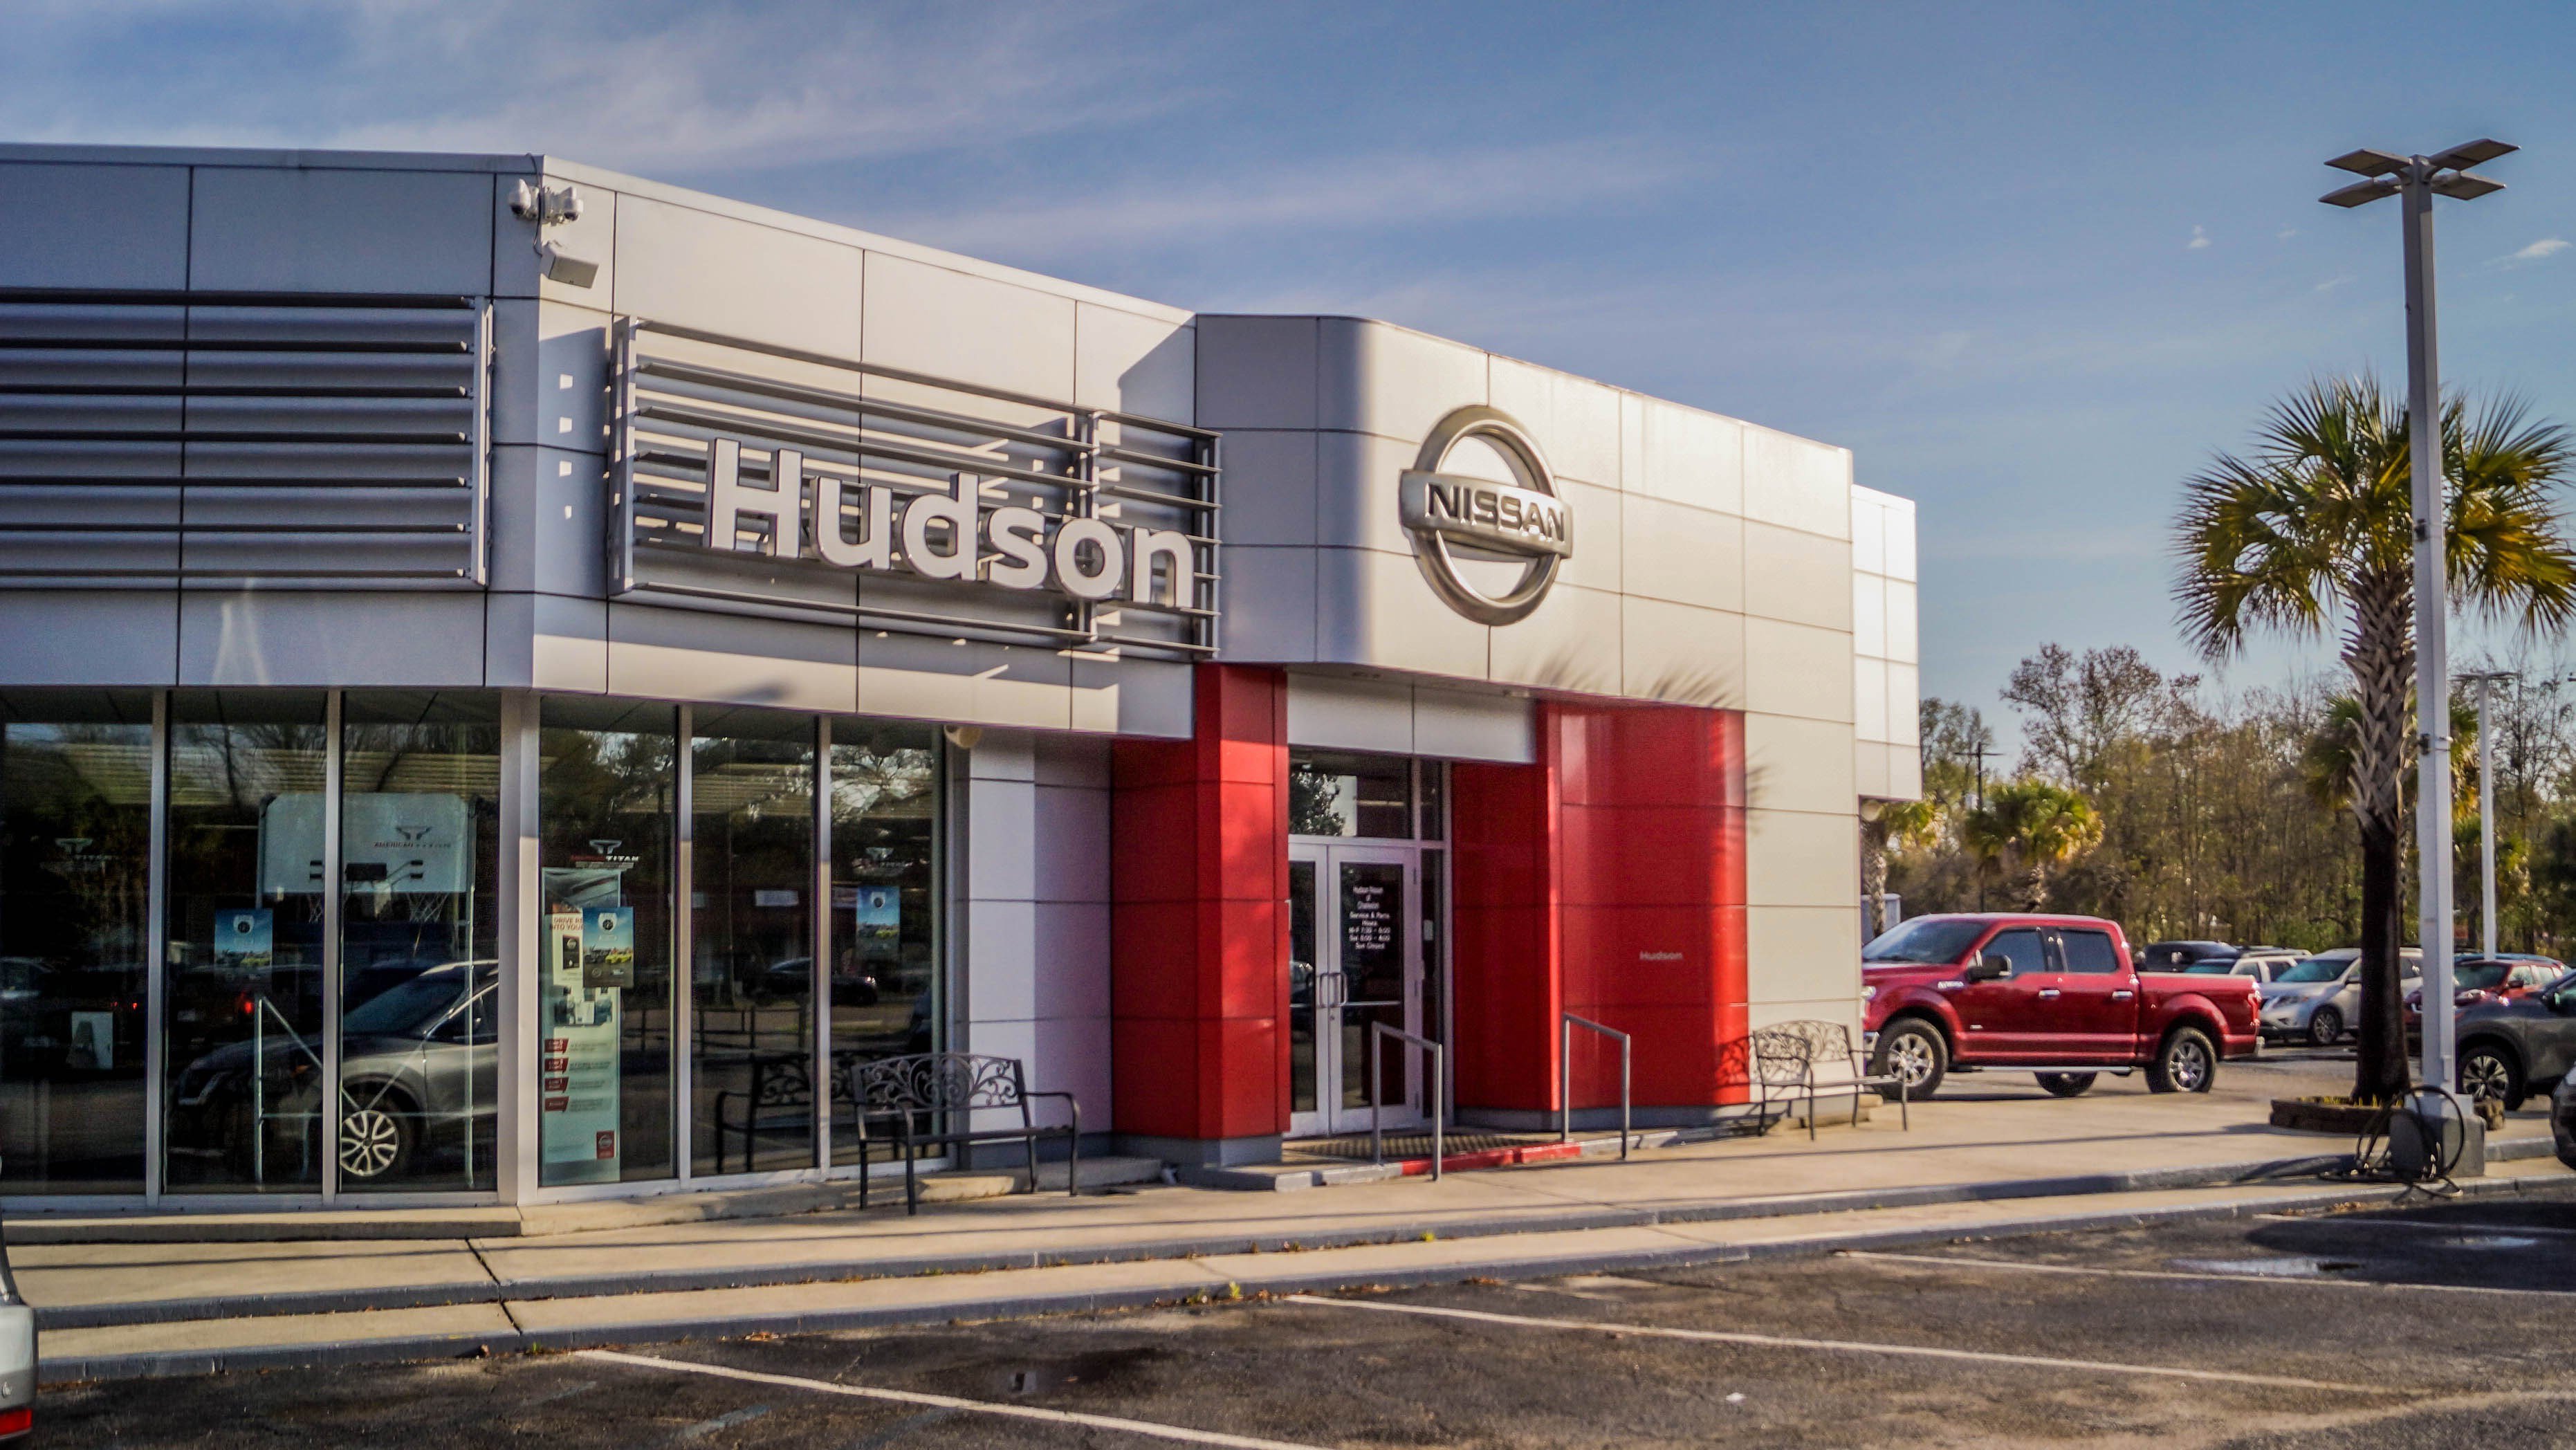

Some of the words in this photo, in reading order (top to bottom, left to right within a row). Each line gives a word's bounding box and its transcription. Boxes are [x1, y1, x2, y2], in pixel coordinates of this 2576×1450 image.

[703, 438, 1195, 607] Hudson
[1424, 482, 1565, 543] NISSAN
[1639, 951, 1683, 960] Hudson
